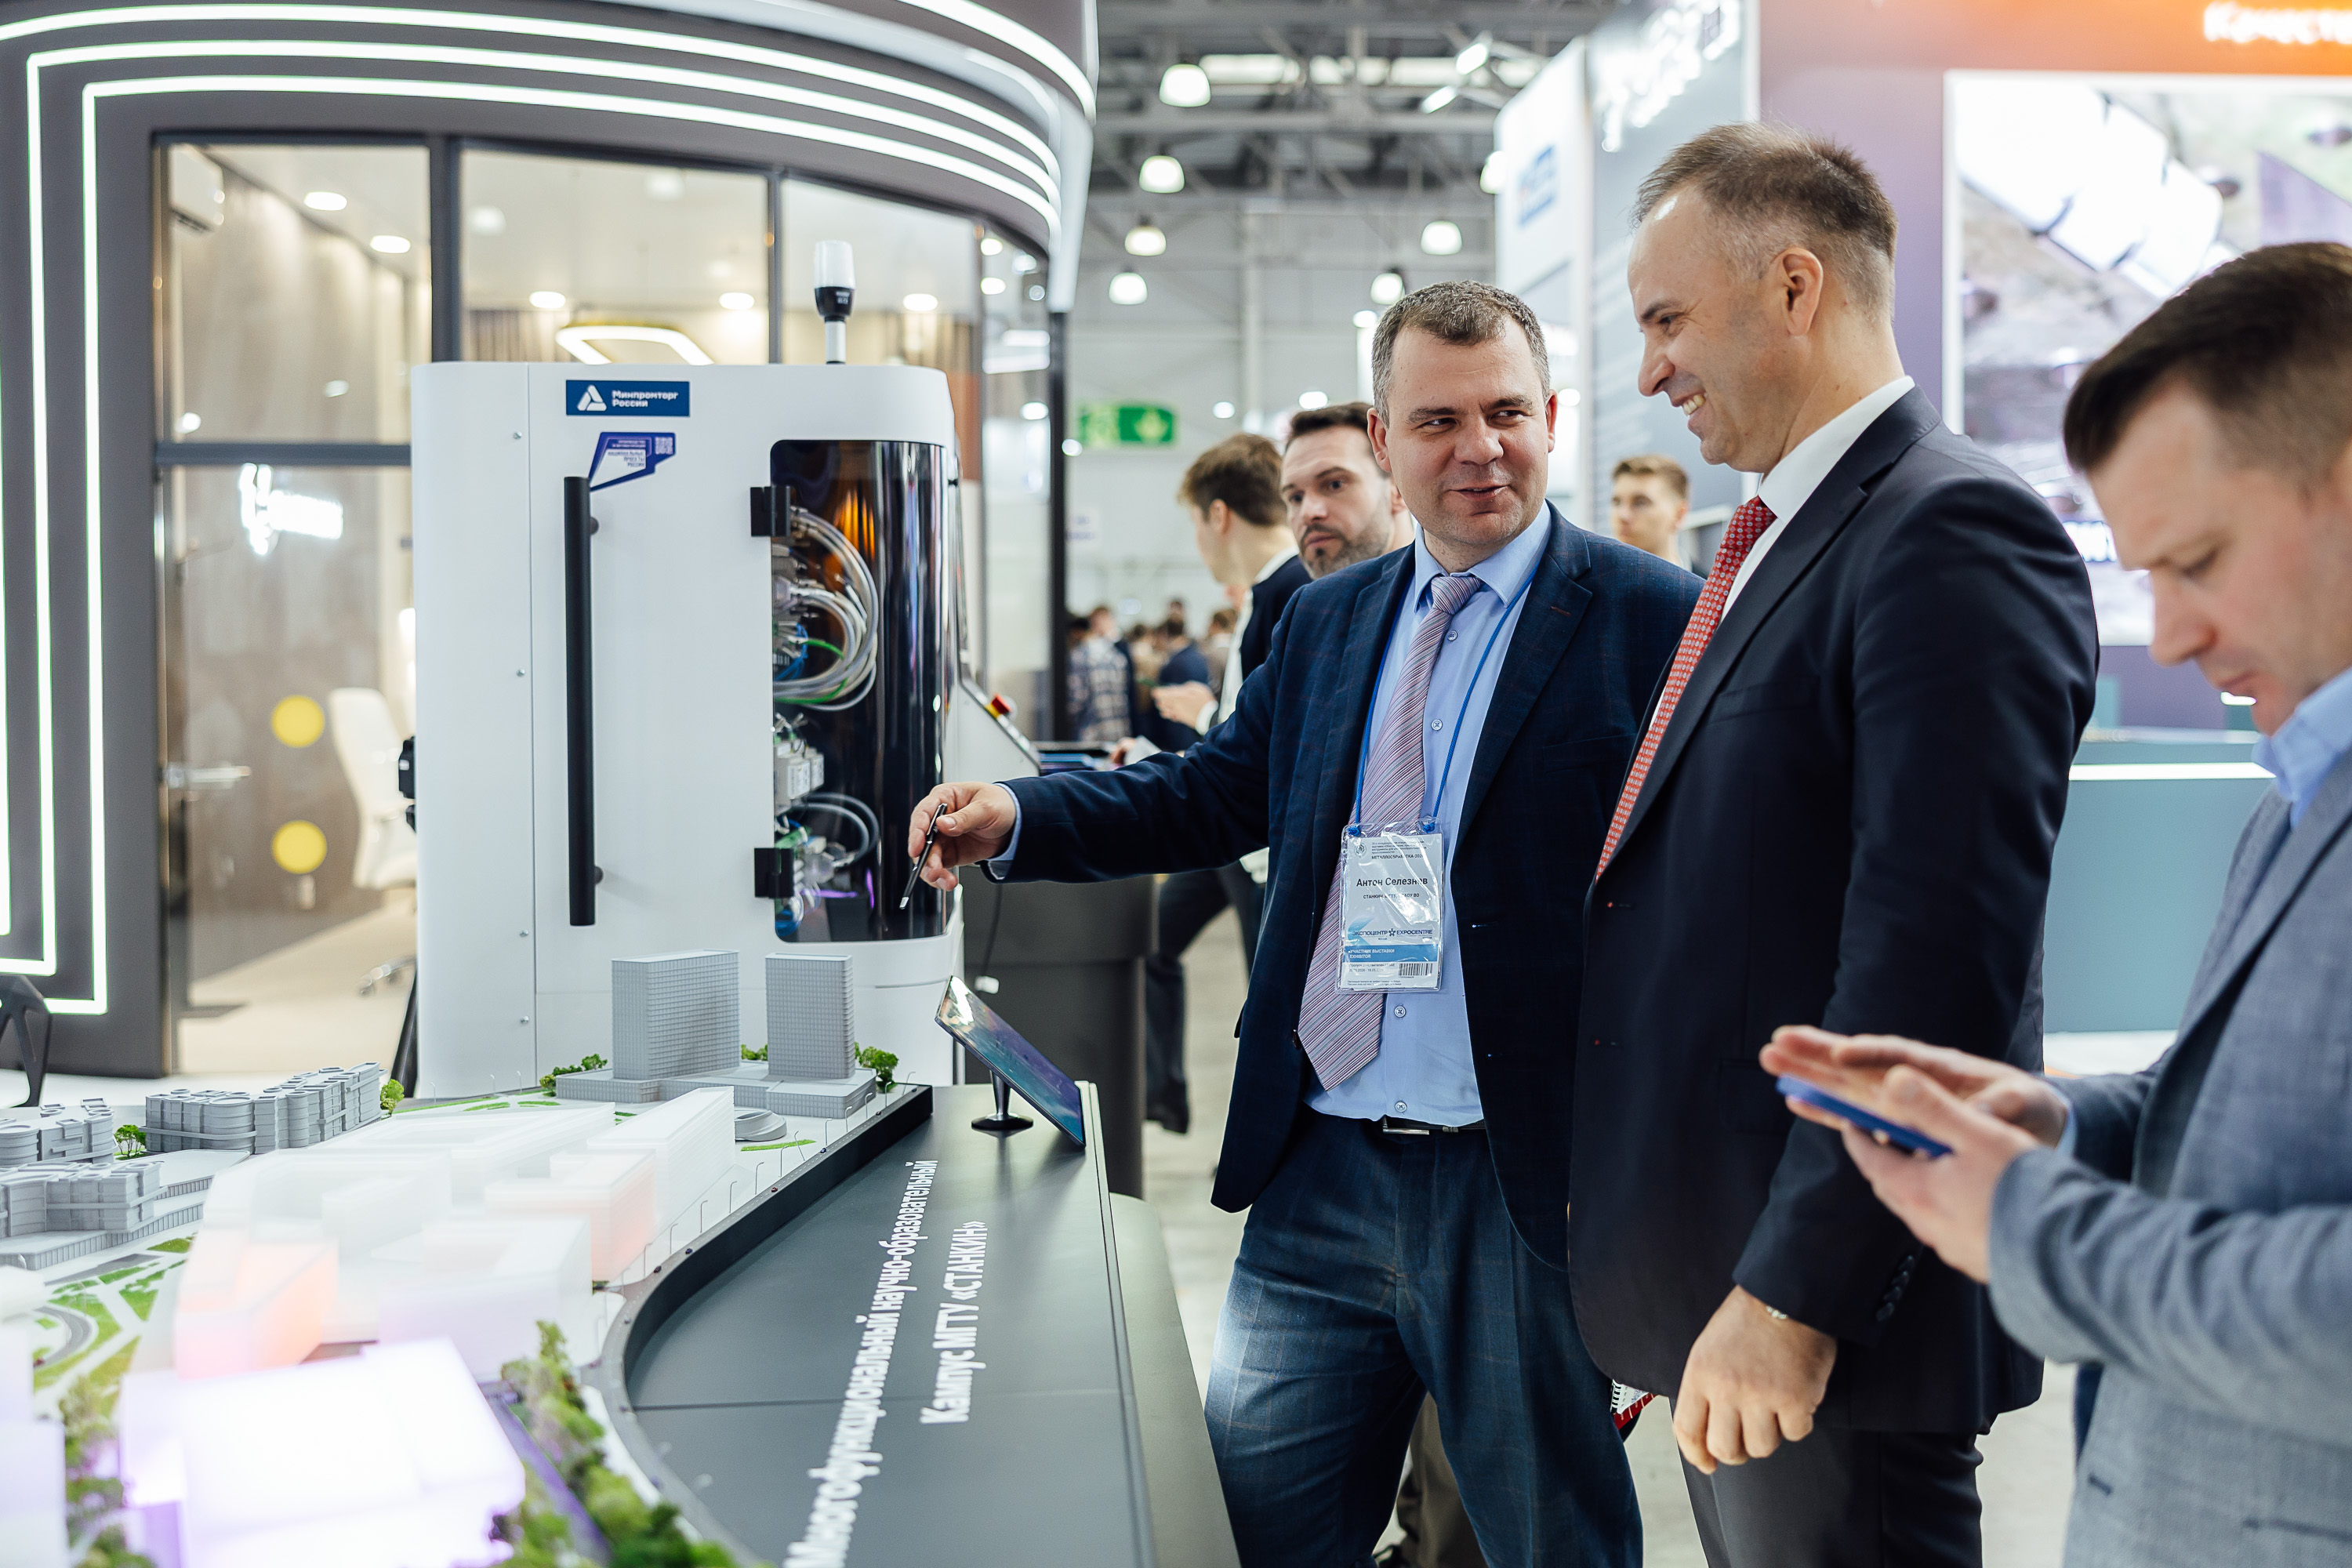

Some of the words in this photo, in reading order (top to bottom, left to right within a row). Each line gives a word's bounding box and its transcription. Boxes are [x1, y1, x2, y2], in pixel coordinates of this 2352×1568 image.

[612, 390, 679, 401] Минпромторг
[612, 398, 648, 407] России
[1356, 878, 1383, 887] Антон
[870, 1160, 938, 1311] научно-образовательный
[943, 1221, 988, 1301] «СТАНКИН»
[932, 1302, 979, 1348] МГТУ
[920, 1349, 986, 1424] Кампус
